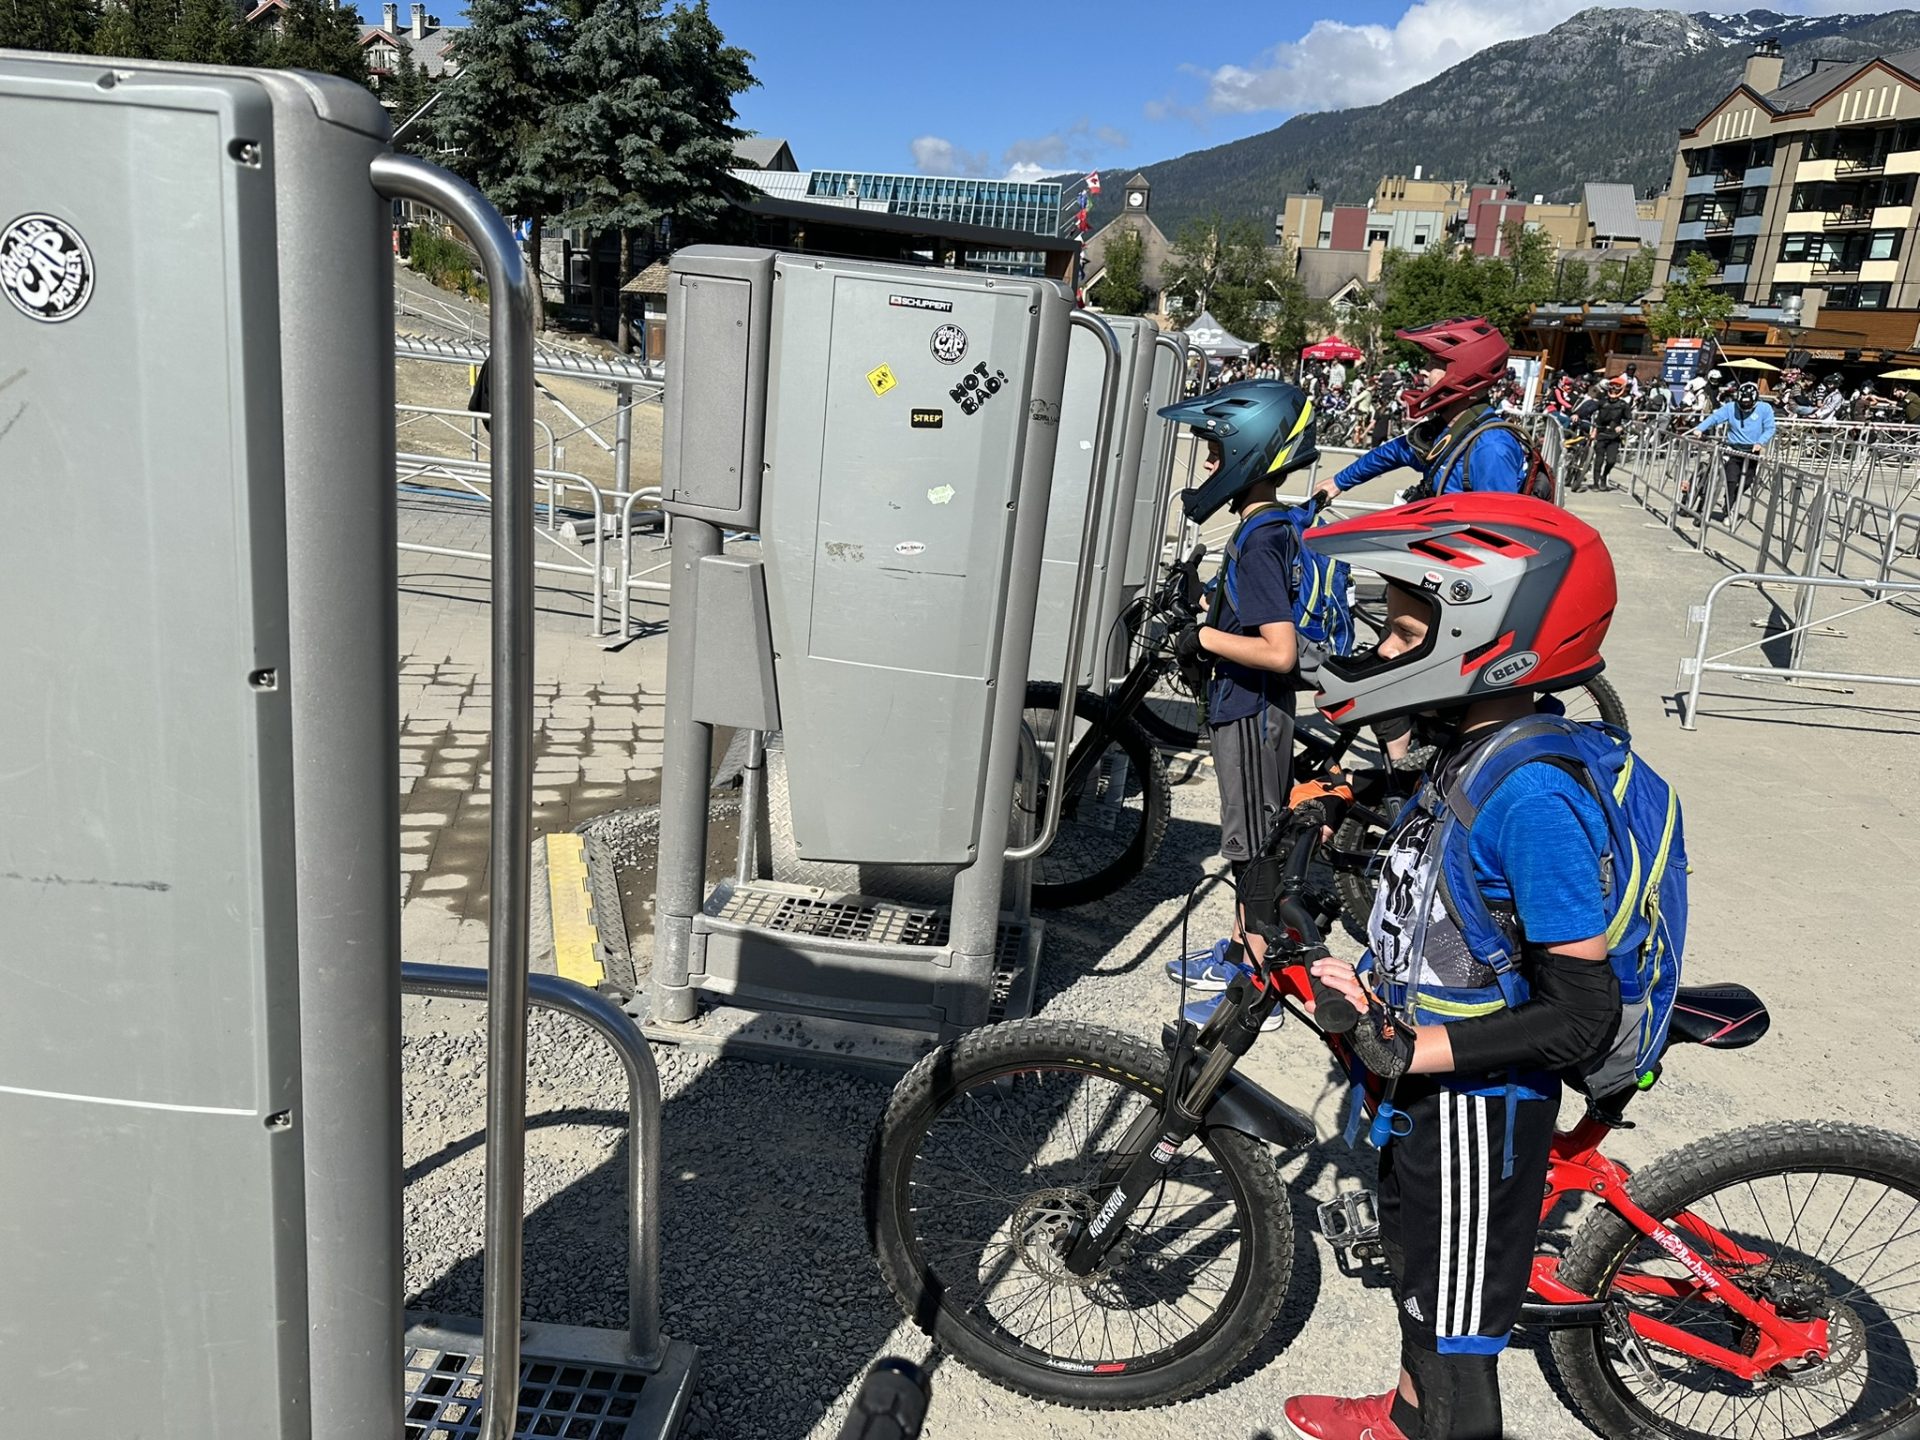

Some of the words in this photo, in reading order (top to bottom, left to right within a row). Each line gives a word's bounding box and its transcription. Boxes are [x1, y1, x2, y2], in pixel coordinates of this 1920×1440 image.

[16, 231, 67, 308] CAP
[49, 249, 82, 311] DEALER
[901, 297, 952, 311] SCHUPPERT
[935, 335, 964, 353] CAP
[949, 361, 989, 404] NOT
[961, 369, 1009, 416] BAD!
[1423, 581, 1436, 591] SM
[1491, 657, 1533, 681] BELL
